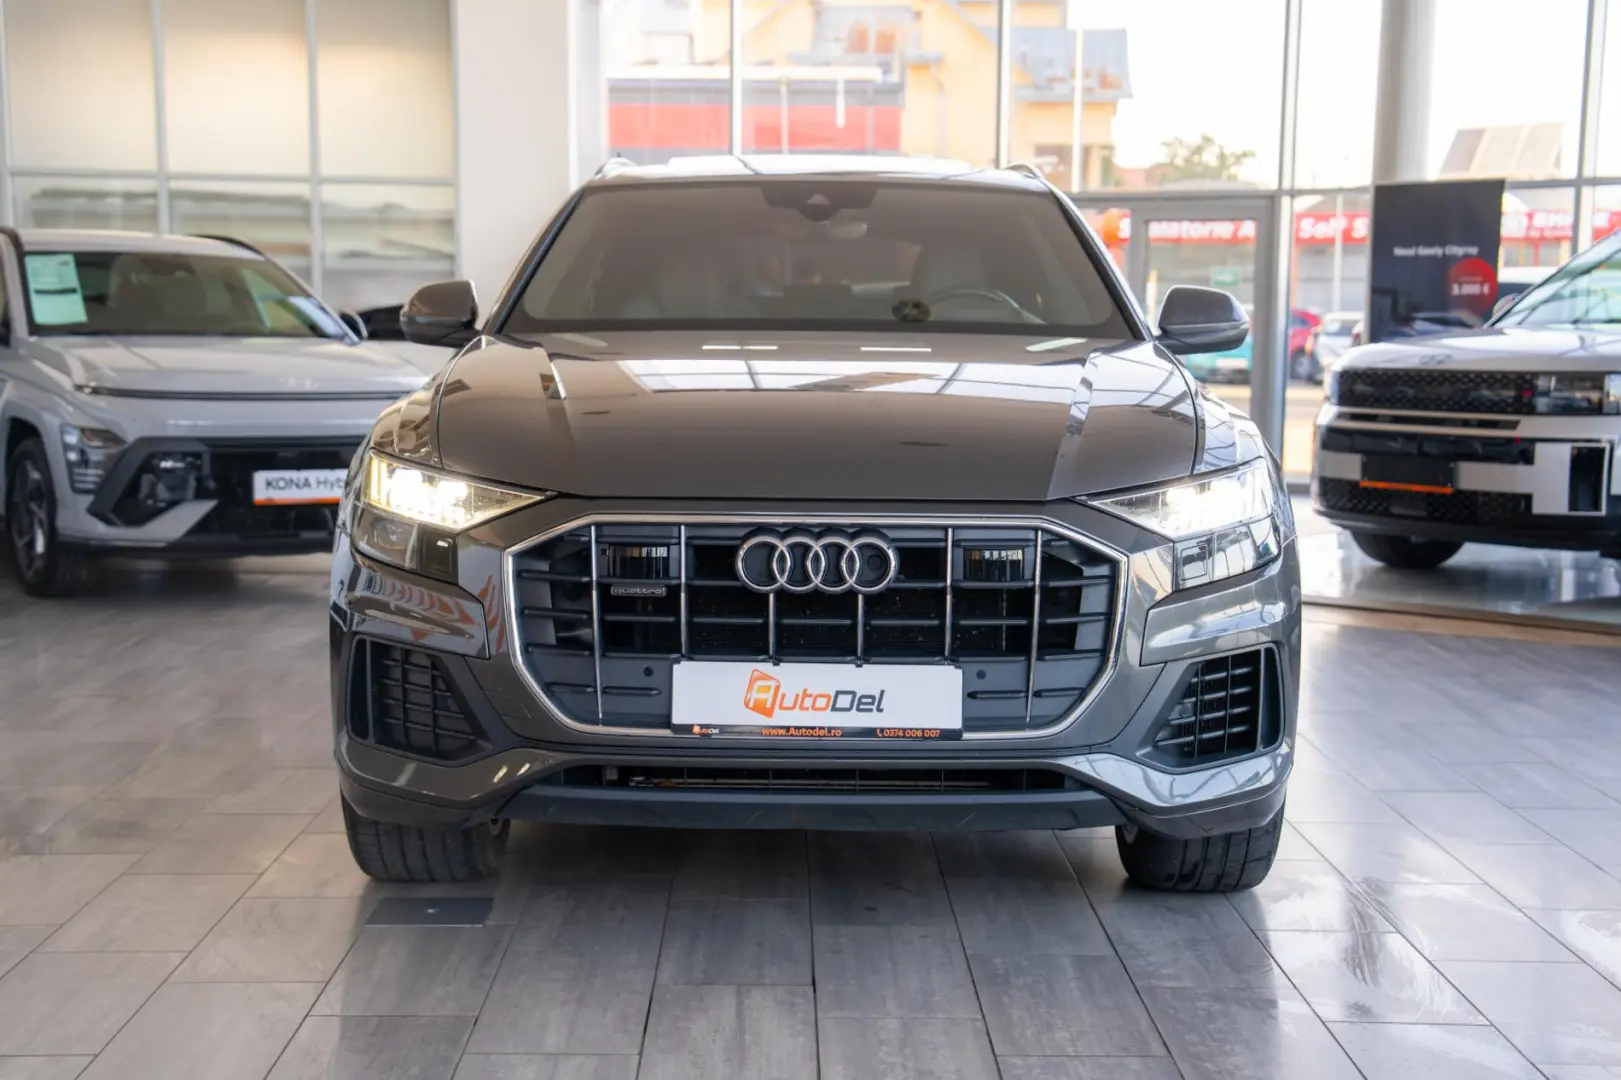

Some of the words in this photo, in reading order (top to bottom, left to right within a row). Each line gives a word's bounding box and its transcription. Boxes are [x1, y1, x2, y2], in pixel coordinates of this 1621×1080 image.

[265, 476, 313, 491] KONA
[614, 587, 663, 596] quattro
[747, 678, 885, 714] AutoDel
[761, 727, 842, 737] www.Autodel.ro
[883, 728, 904, 738] 0374
[924, 729, 941, 738] 007
